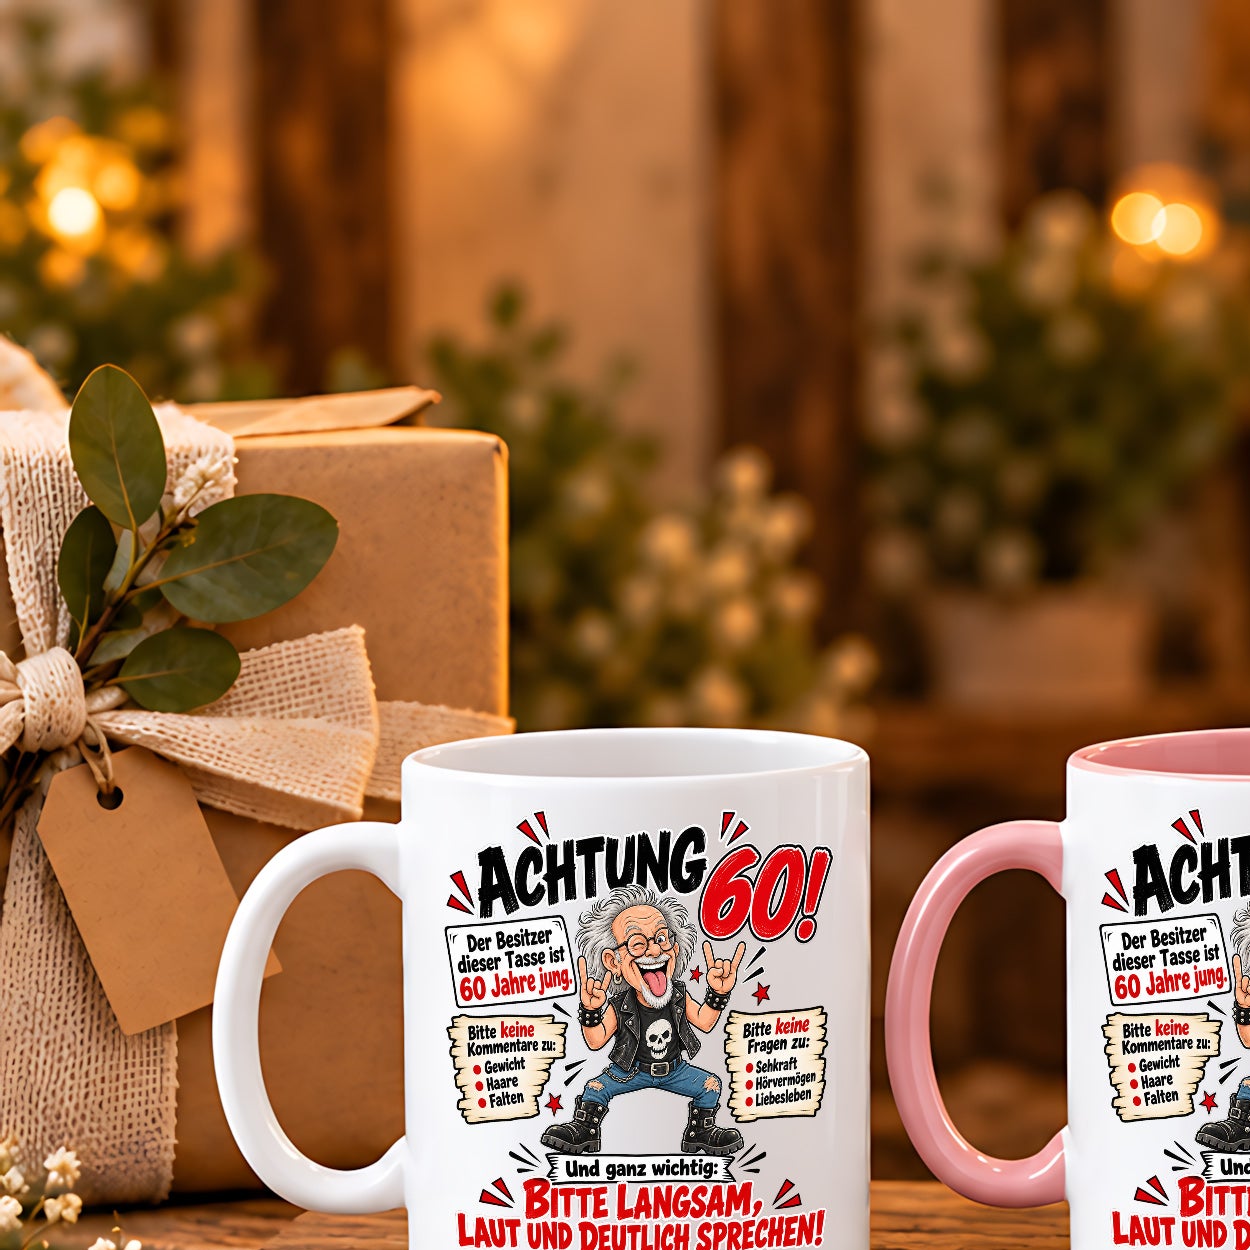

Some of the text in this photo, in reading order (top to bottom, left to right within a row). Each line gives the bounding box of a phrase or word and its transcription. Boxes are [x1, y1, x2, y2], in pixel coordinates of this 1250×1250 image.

[478, 827, 707, 918] ACHTUNG
[699, 844, 833, 943] 60!
[466, 928, 552, 952] Der Besitzer
[1121, 926, 1207, 950] Der Besitzer
[457, 946, 565, 973] dieser Tasse ist
[459, 967, 573, 1001] 60 Jahre jung.
[1114, 965, 1228, 999] 60 Jahre jung.
[743, 1016, 810, 1039] Bitte keine
[1123, 1019, 1189, 1039] Bitte keine
[747, 1037, 810, 1054] Fragen zu:
[1122, 1037, 1211, 1055] Kommentare zu:
[756, 1057, 797, 1074] Sehkraft
[1139, 1055, 1180, 1072] Gewicht
[756, 1072, 816, 1090] Hörvermögen
[1141, 1074, 1173, 1090] Haare
[756, 1088, 811, 1107] Liebesleben
[565, 1159, 718, 1180] Und ganz wichtig:
[523, 1177, 762, 1220] BITTE LANGSAM,
[457, 1213, 521, 1248] LAUT
[527, 1222, 573, 1250] UND
[1112, 1211, 1175, 1246] LAUT
[1182, 1220, 1228, 1248] UND
